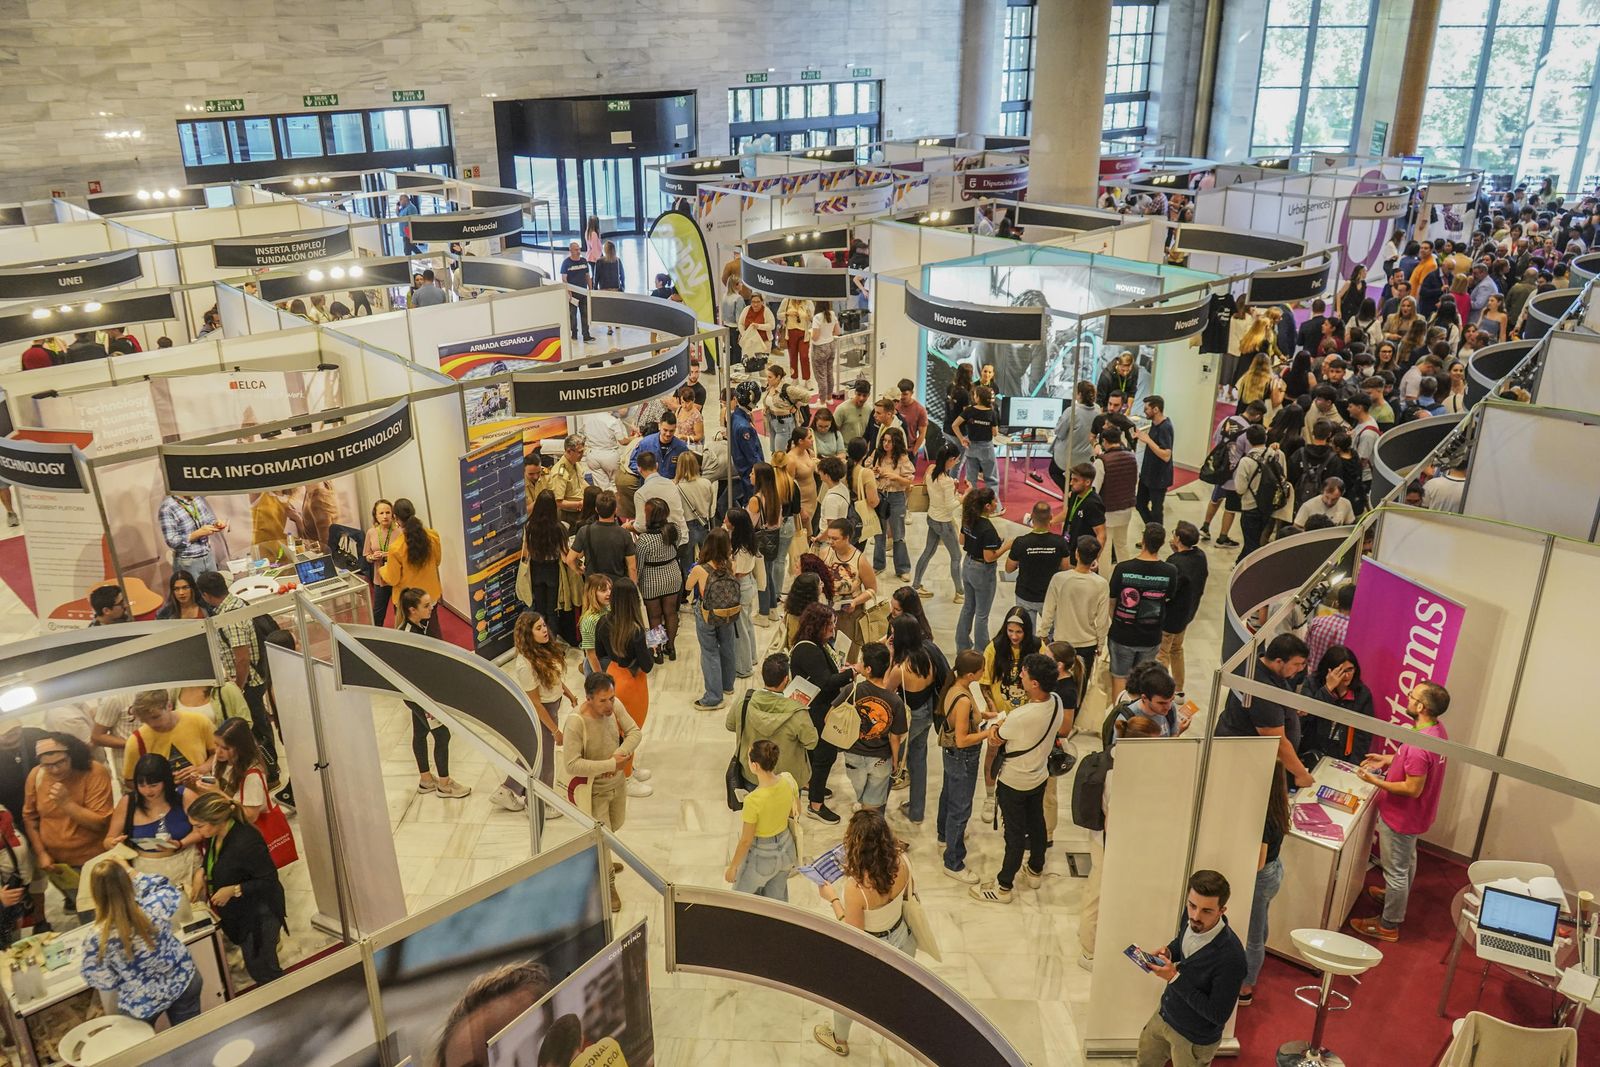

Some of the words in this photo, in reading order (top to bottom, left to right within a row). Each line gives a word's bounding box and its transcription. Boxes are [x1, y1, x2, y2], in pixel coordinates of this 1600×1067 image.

[462, 220, 498, 233] Arquisocial
[255, 245, 290, 255] INSERTA
[291, 240, 322, 252] EMPLEO
[256, 251, 307, 264] FUNDACIÓN
[307, 248, 327, 259] ONCE
[58, 275, 83, 287] UNEI
[757, 274, 774, 287] Valeo
[1115, 283, 1146, 295] NOVATEC
[934, 312, 967, 327] Novatec
[1174, 317, 1200, 330] Novatec
[470, 341, 500, 352] ARMADA
[499, 335, 535, 347] ESPAÑOLA
[238, 380, 267, 390] ELCA
[559, 383, 629, 401] MINISTERIO
[631, 378, 645, 391] DE
[646, 364, 679, 386] DEFENSA
[182, 466, 222, 479] ELCA
[225, 450, 335, 478] INFORMATION
[336, 419, 404, 460] TECHNOLOGY
